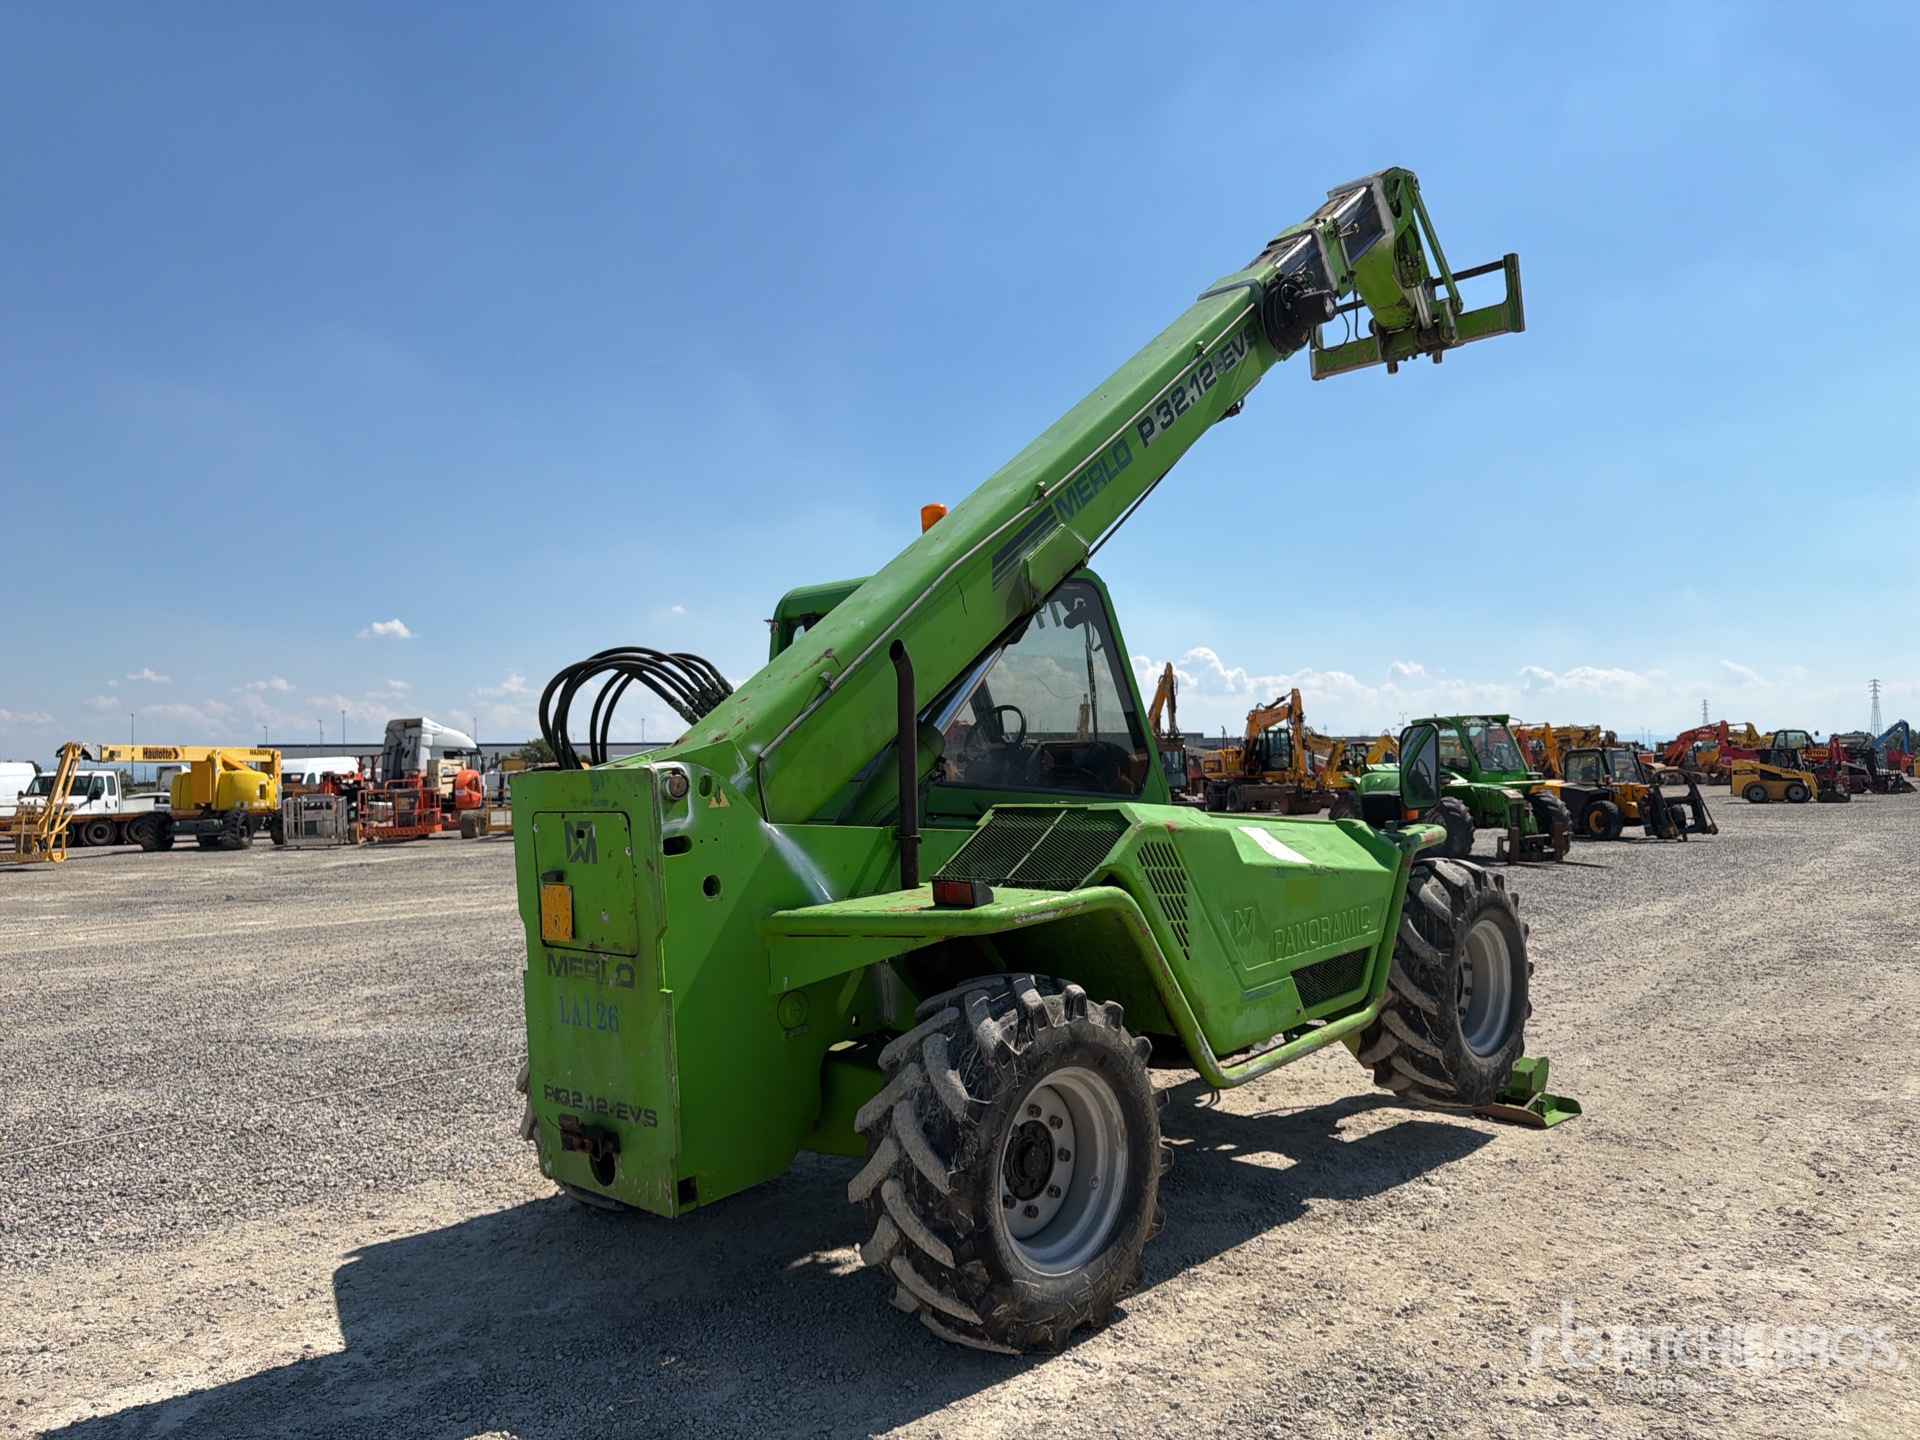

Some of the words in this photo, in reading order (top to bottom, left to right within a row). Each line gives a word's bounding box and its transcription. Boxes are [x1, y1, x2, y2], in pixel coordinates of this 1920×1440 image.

[1054, 438, 1134, 523] MERLO
[143, 747, 172, 760] Haulotte
[1273, 905, 1371, 958] PANORAMIC
[546, 953, 636, 989] MERLO
